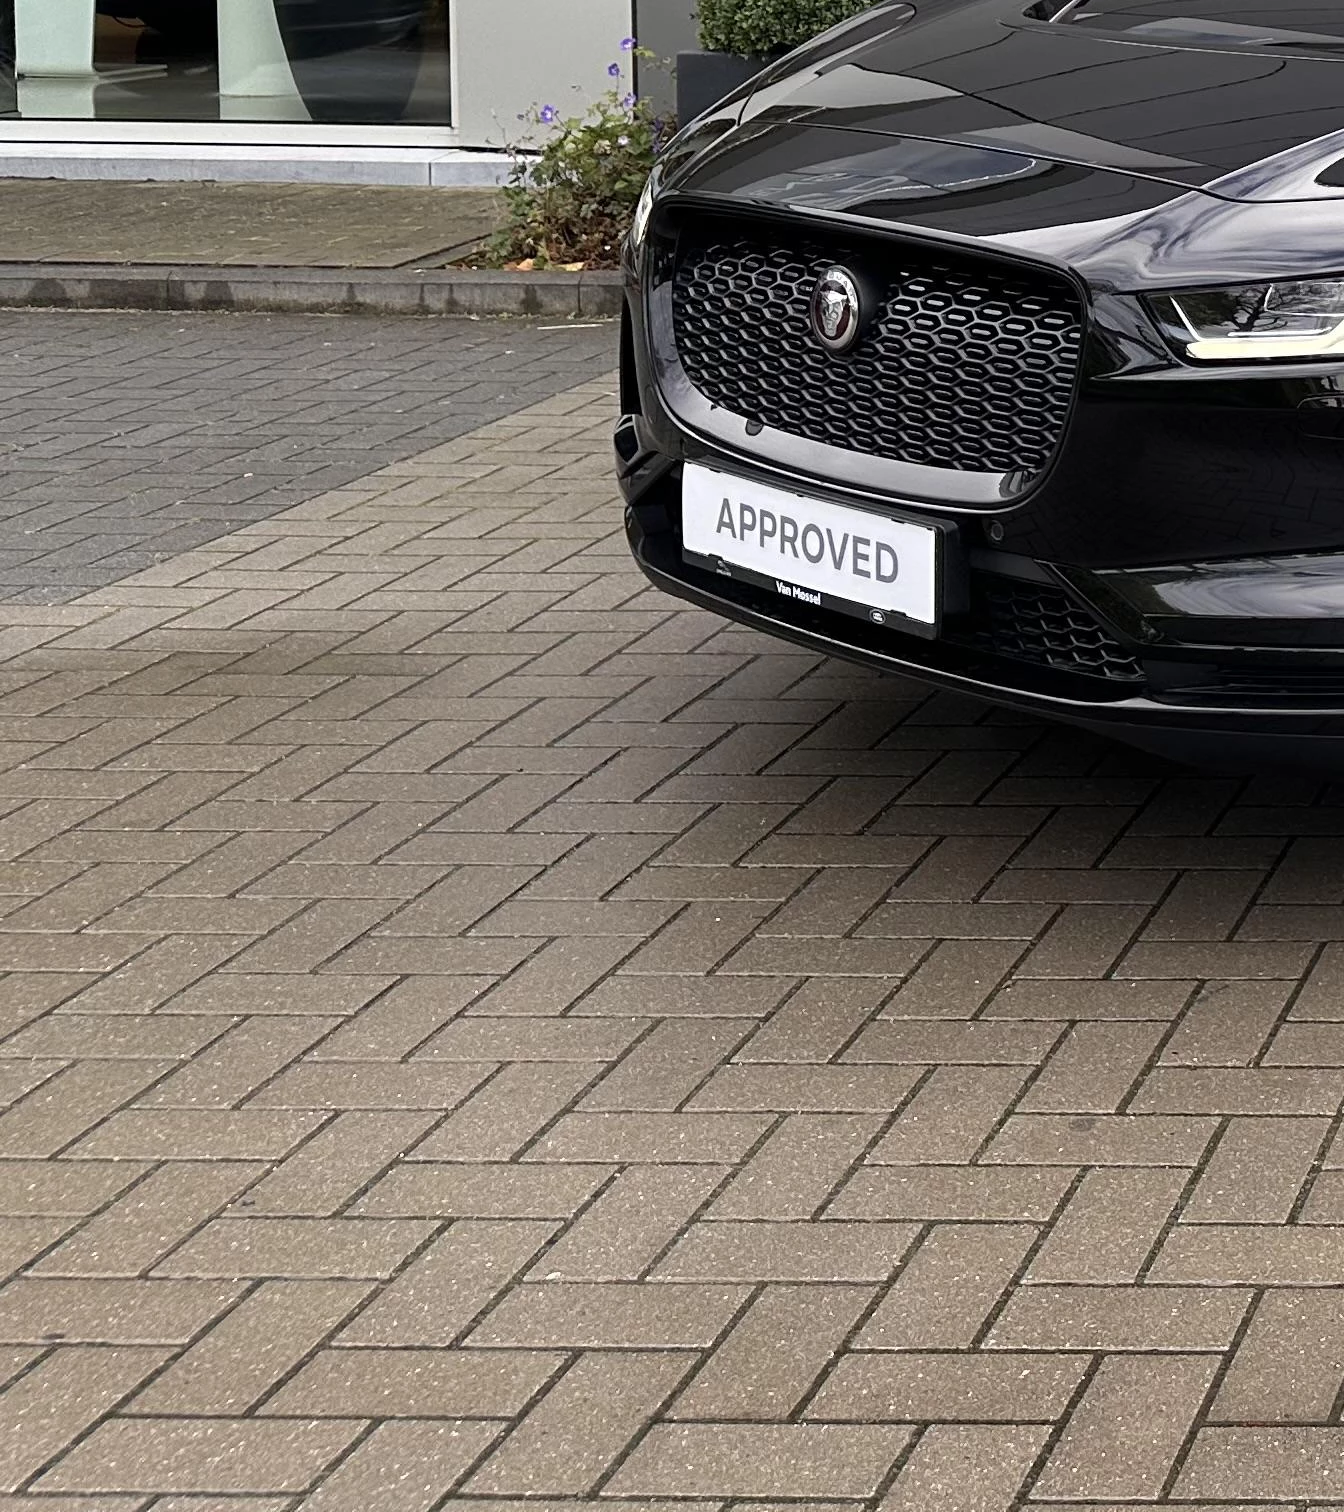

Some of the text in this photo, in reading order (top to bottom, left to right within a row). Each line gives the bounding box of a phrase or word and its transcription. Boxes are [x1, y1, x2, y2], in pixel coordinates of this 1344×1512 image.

[715, 496, 900, 584] APPROVED
[775, 580, 822, 606] Van Mossel
